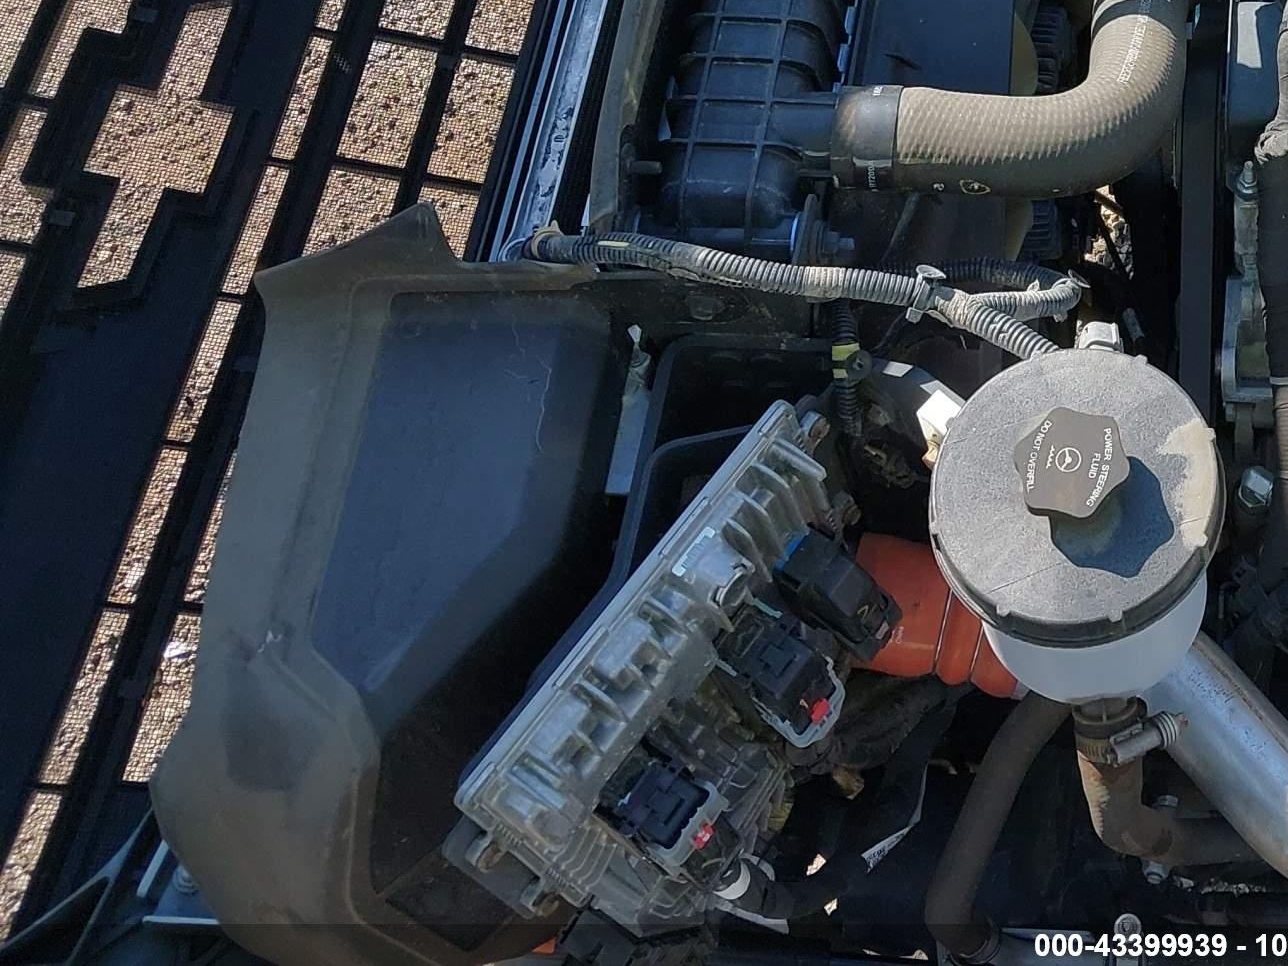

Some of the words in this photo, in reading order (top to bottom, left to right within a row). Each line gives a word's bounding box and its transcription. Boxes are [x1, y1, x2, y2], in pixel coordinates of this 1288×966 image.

[1040, 419, 1052, 433] DO
[1033, 433, 1045, 451] NOT
[1103, 427, 1113, 461] POWER
[1026, 452, 1038, 494] OVERFILL
[1088, 452, 1101, 479] FLUID
[1086, 464, 1110, 507] STEERING
